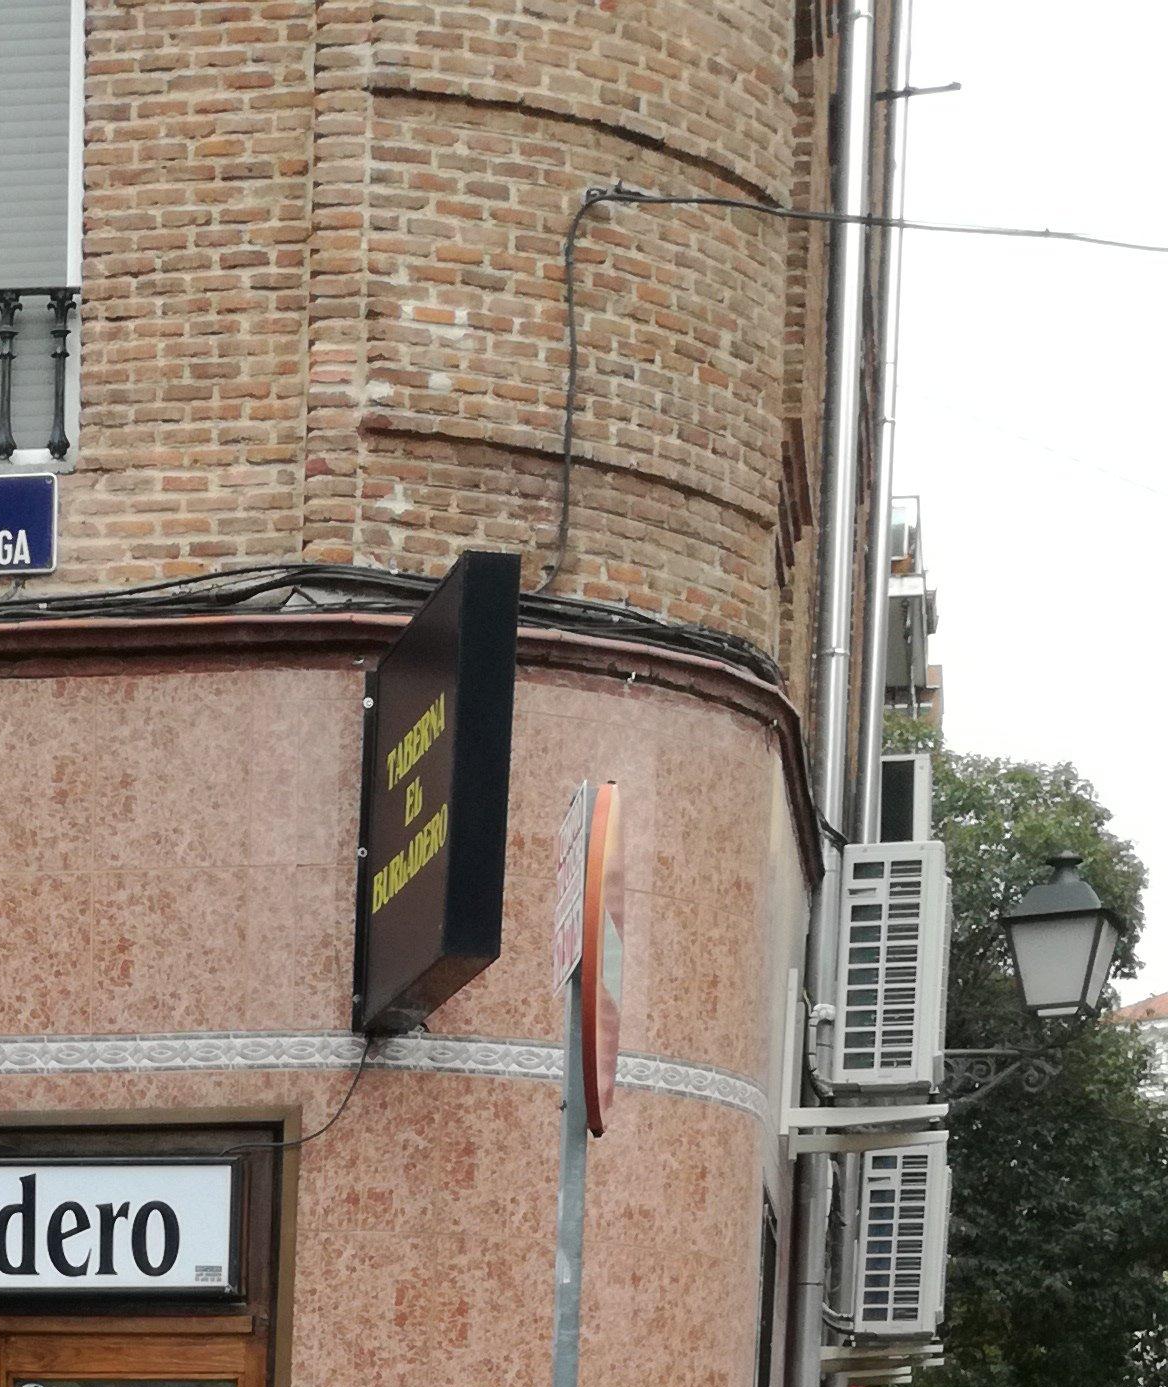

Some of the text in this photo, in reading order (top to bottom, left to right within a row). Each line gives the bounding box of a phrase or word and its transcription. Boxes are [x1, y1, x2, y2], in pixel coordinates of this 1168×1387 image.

[387, 691, 445, 790] TABERNA
[404, 776, 422, 827] EL
[372, 803, 448, 914] BURLADERO
